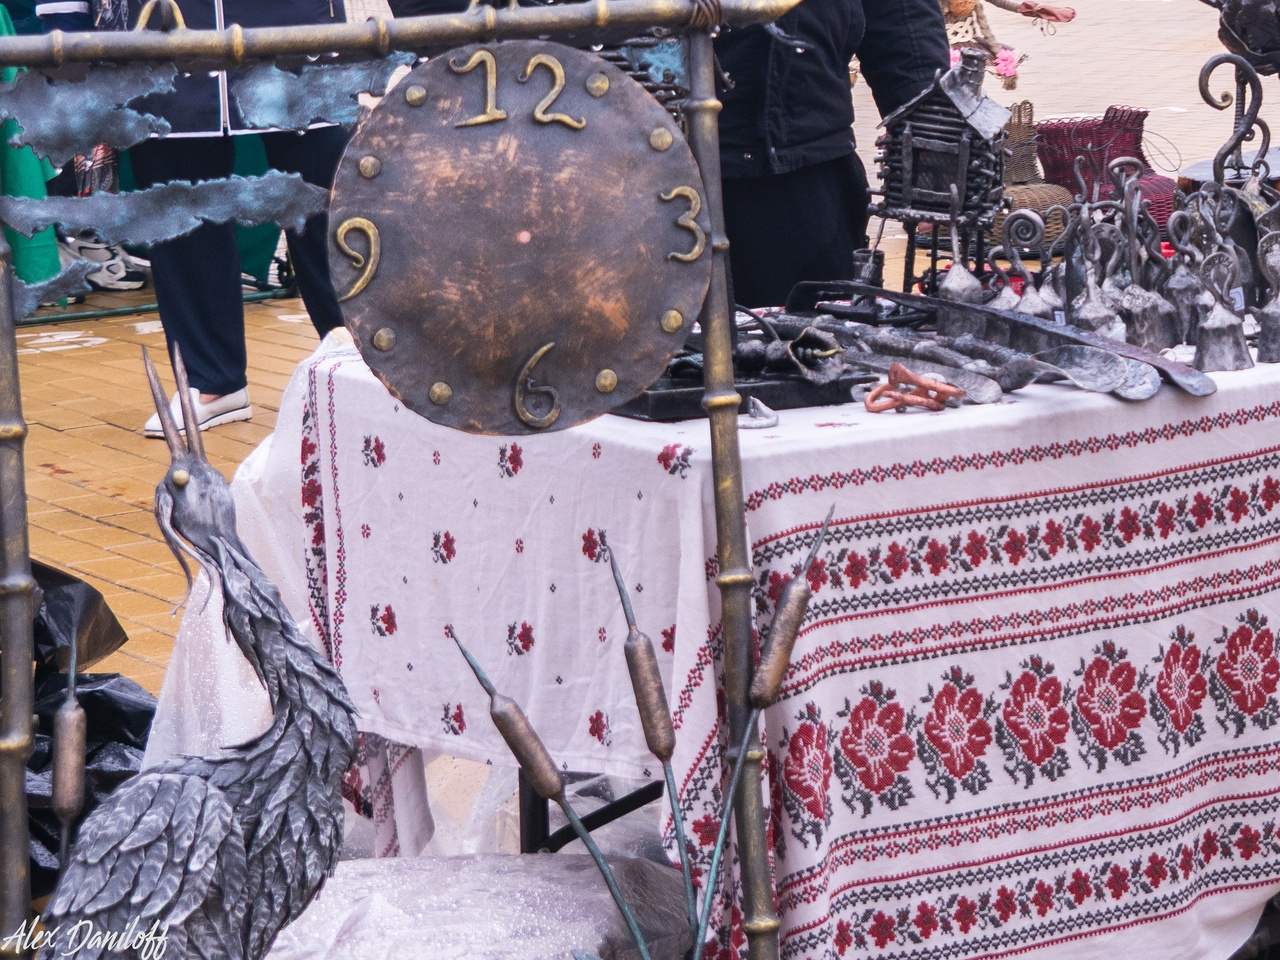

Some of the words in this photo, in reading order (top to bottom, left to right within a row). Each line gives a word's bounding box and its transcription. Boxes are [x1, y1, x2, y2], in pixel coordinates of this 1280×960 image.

[449, 49, 586, 130] 12
[336, 217, 381, 302] 9
[658, 185, 706, 262] 3
[514, 342, 561, 429] 6
